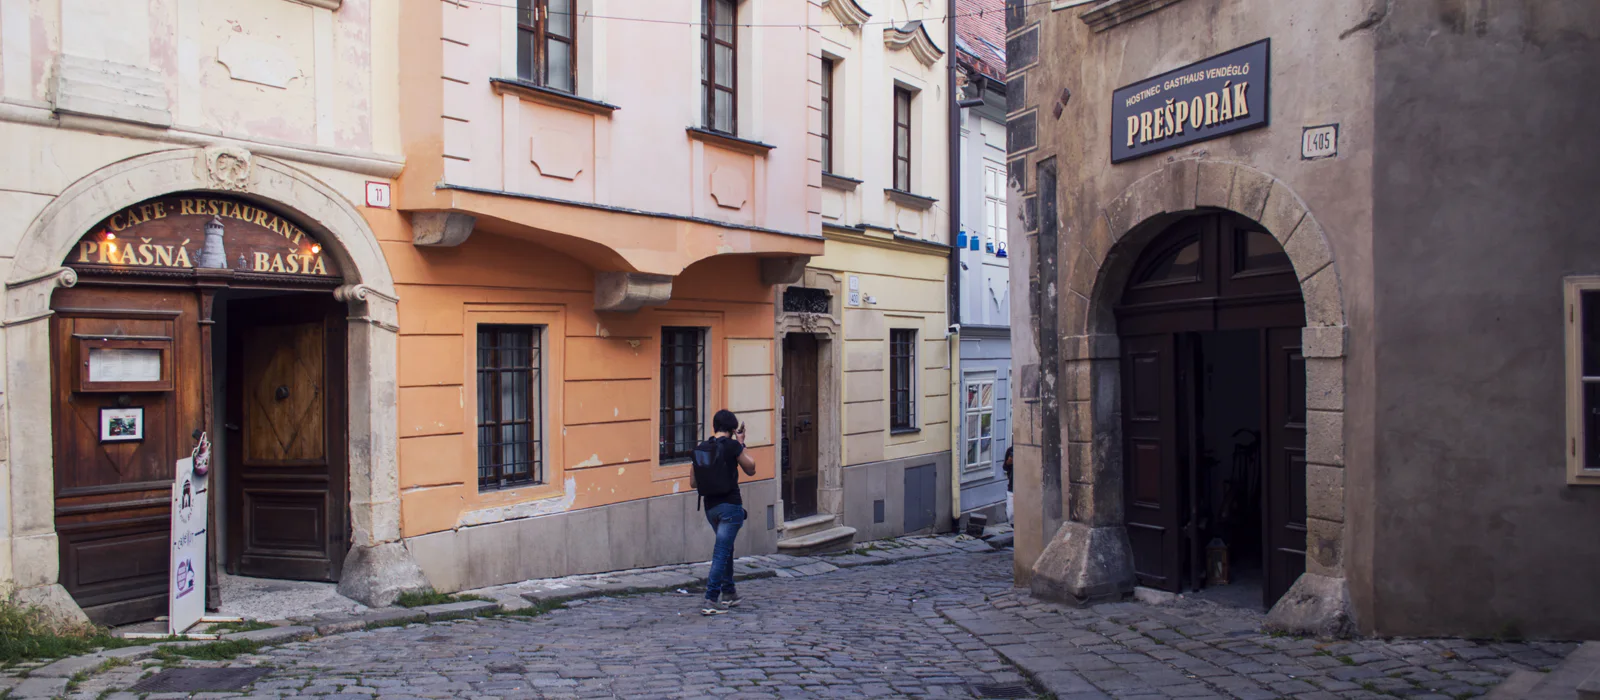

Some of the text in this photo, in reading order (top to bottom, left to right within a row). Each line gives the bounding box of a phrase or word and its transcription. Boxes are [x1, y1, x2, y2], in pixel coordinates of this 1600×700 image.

[1125, 62, 1250, 107] HOSTINEC GASTHAUS VENDÉGLŐ
[1126, 79, 1250, 148] PREŠPORÁK
[375, 188, 383, 202] 11
[110, 199, 306, 246] CAFE RESTAURANT
[78, 237, 328, 275] PRAŠNÁ BAŠTA
